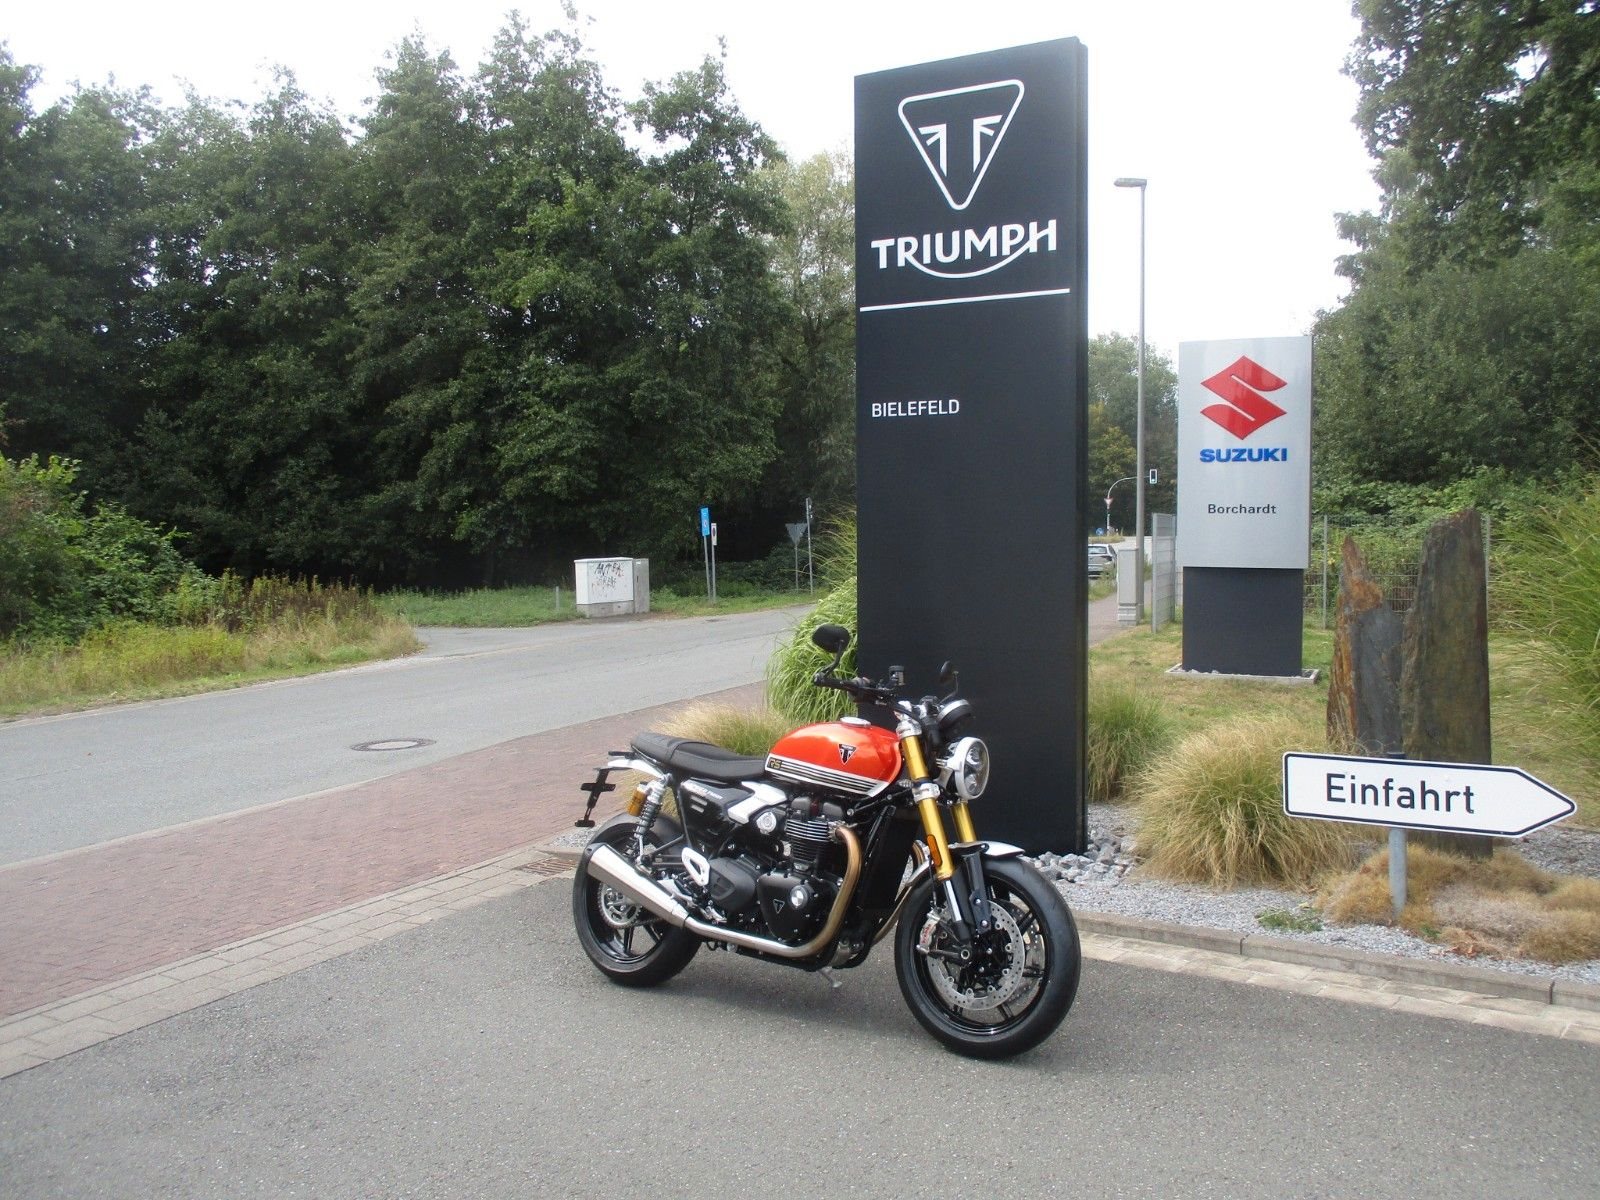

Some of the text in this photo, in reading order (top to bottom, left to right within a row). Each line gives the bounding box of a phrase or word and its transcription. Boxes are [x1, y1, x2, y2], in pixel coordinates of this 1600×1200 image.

[870, 218, 1057, 279] TRIUMPH
[871, 398, 960, 418] BIELEFELD
[1199, 447, 1288, 463] SUZUKI
[1207, 503, 1277, 514] Borchardt
[767, 757, 781, 769] RS
[1326, 772, 1475, 814] Einfahrt
